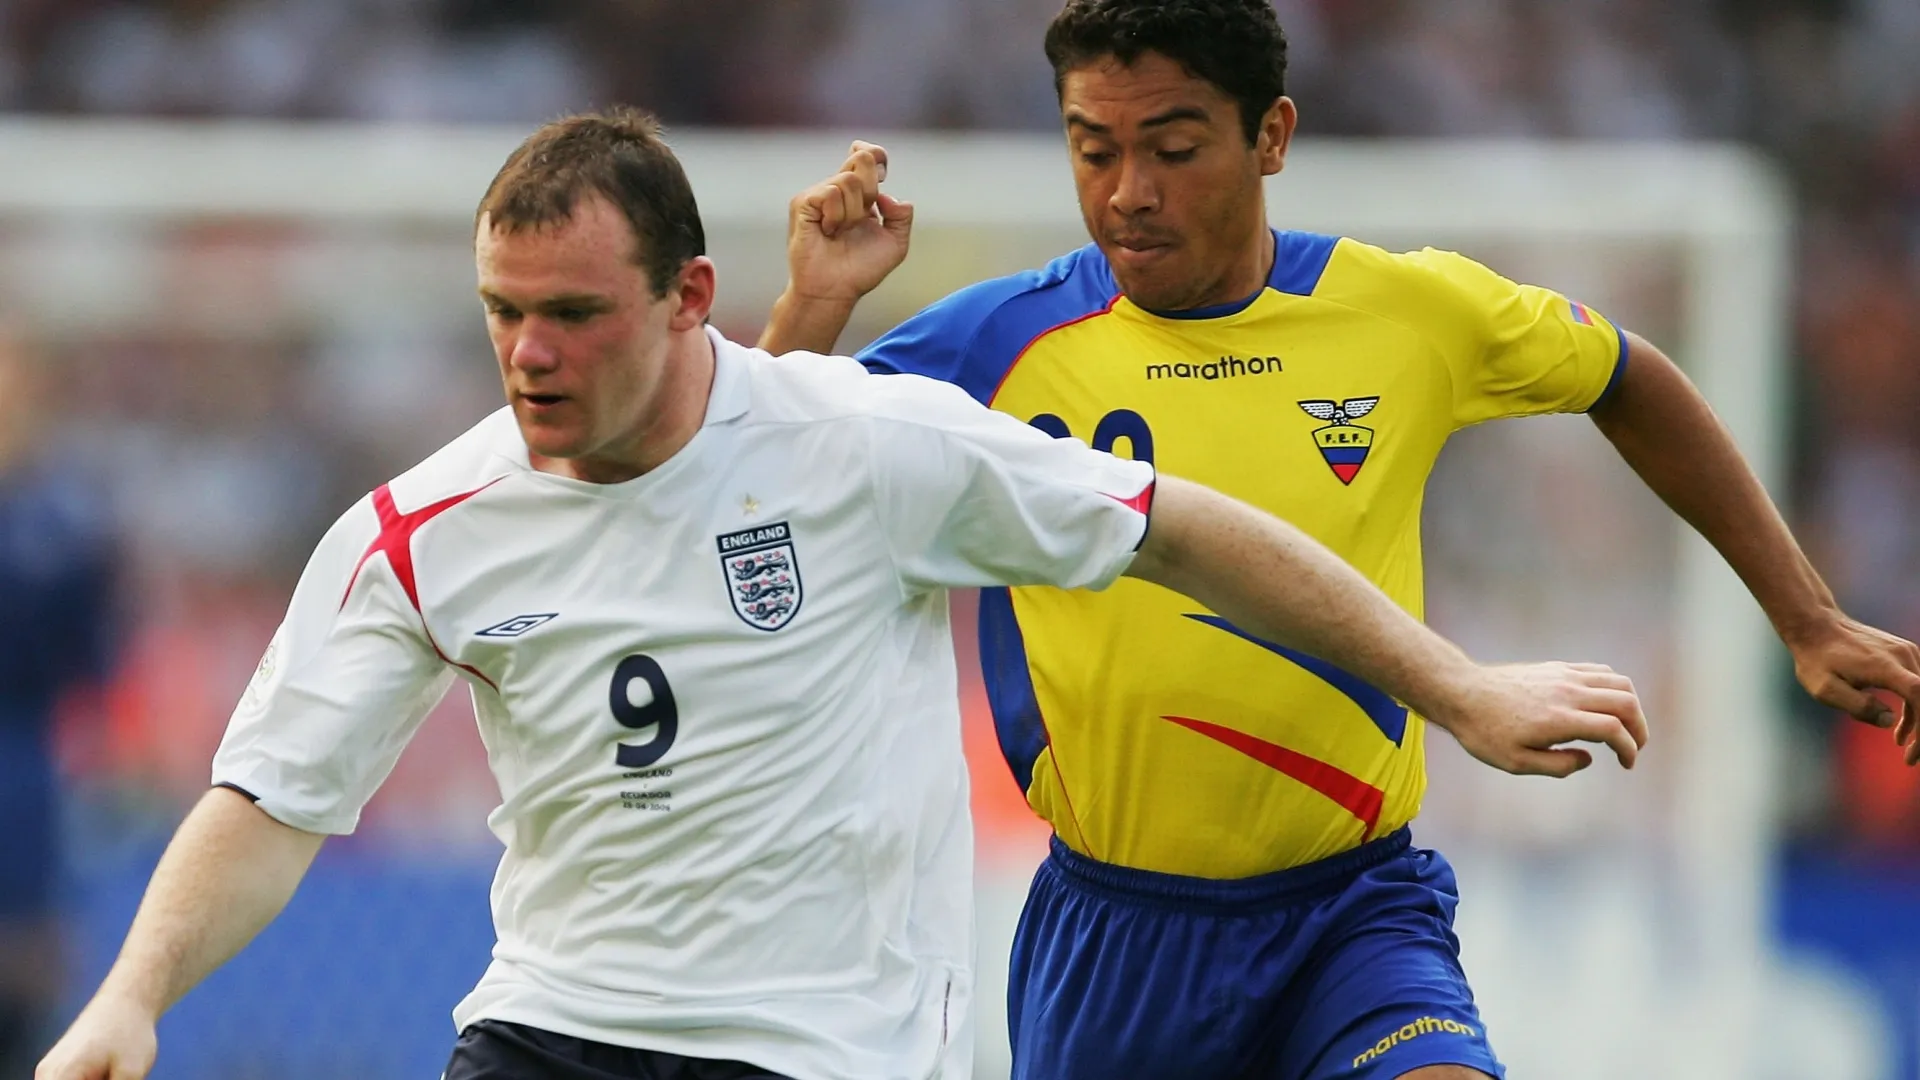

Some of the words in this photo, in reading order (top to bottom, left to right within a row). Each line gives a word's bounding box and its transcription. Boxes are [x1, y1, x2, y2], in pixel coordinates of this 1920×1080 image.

[1146, 355, 1283, 380] marathon
[722, 526, 786, 549] ENGLAND
[609, 654, 678, 768] 9
[620, 791, 672, 800] ECUADOR
[1353, 1016, 1476, 1068] marathon
